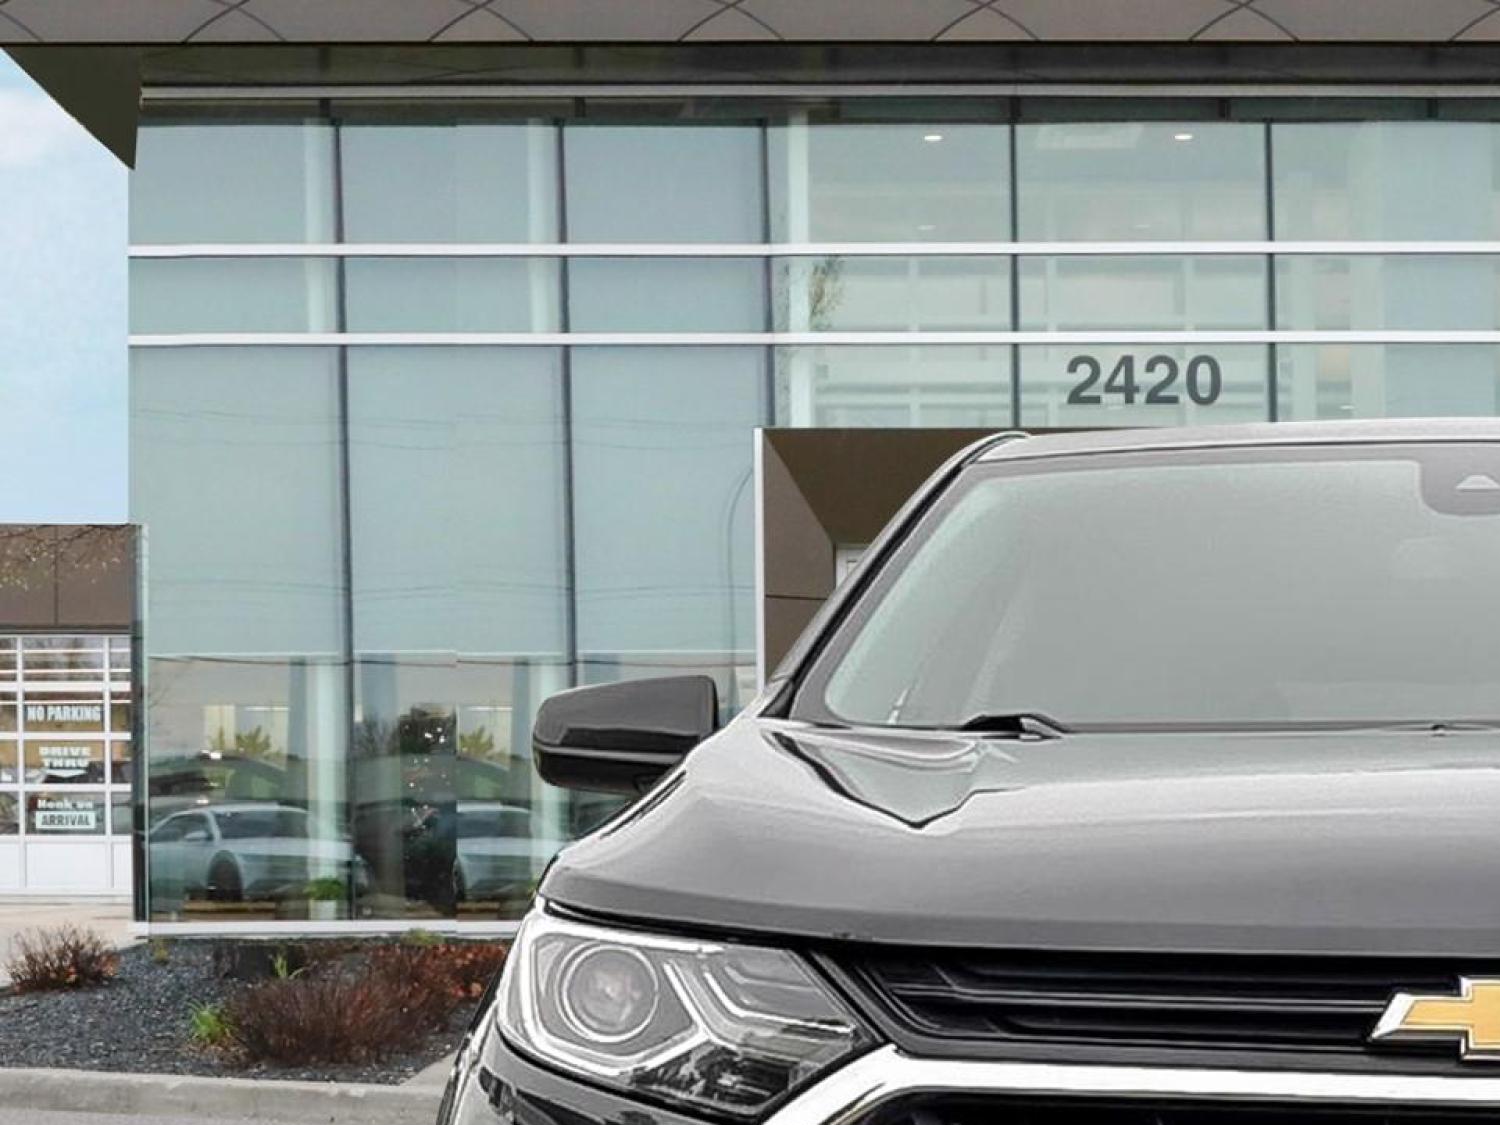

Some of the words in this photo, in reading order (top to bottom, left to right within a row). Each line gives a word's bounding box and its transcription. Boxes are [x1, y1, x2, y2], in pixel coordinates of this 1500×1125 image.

[1067, 355, 1221, 406] 2420
[27, 705, 44, 721] NO
[47, 705, 101, 722] PARKING
[41, 813, 91, 826] ARRIVAL
